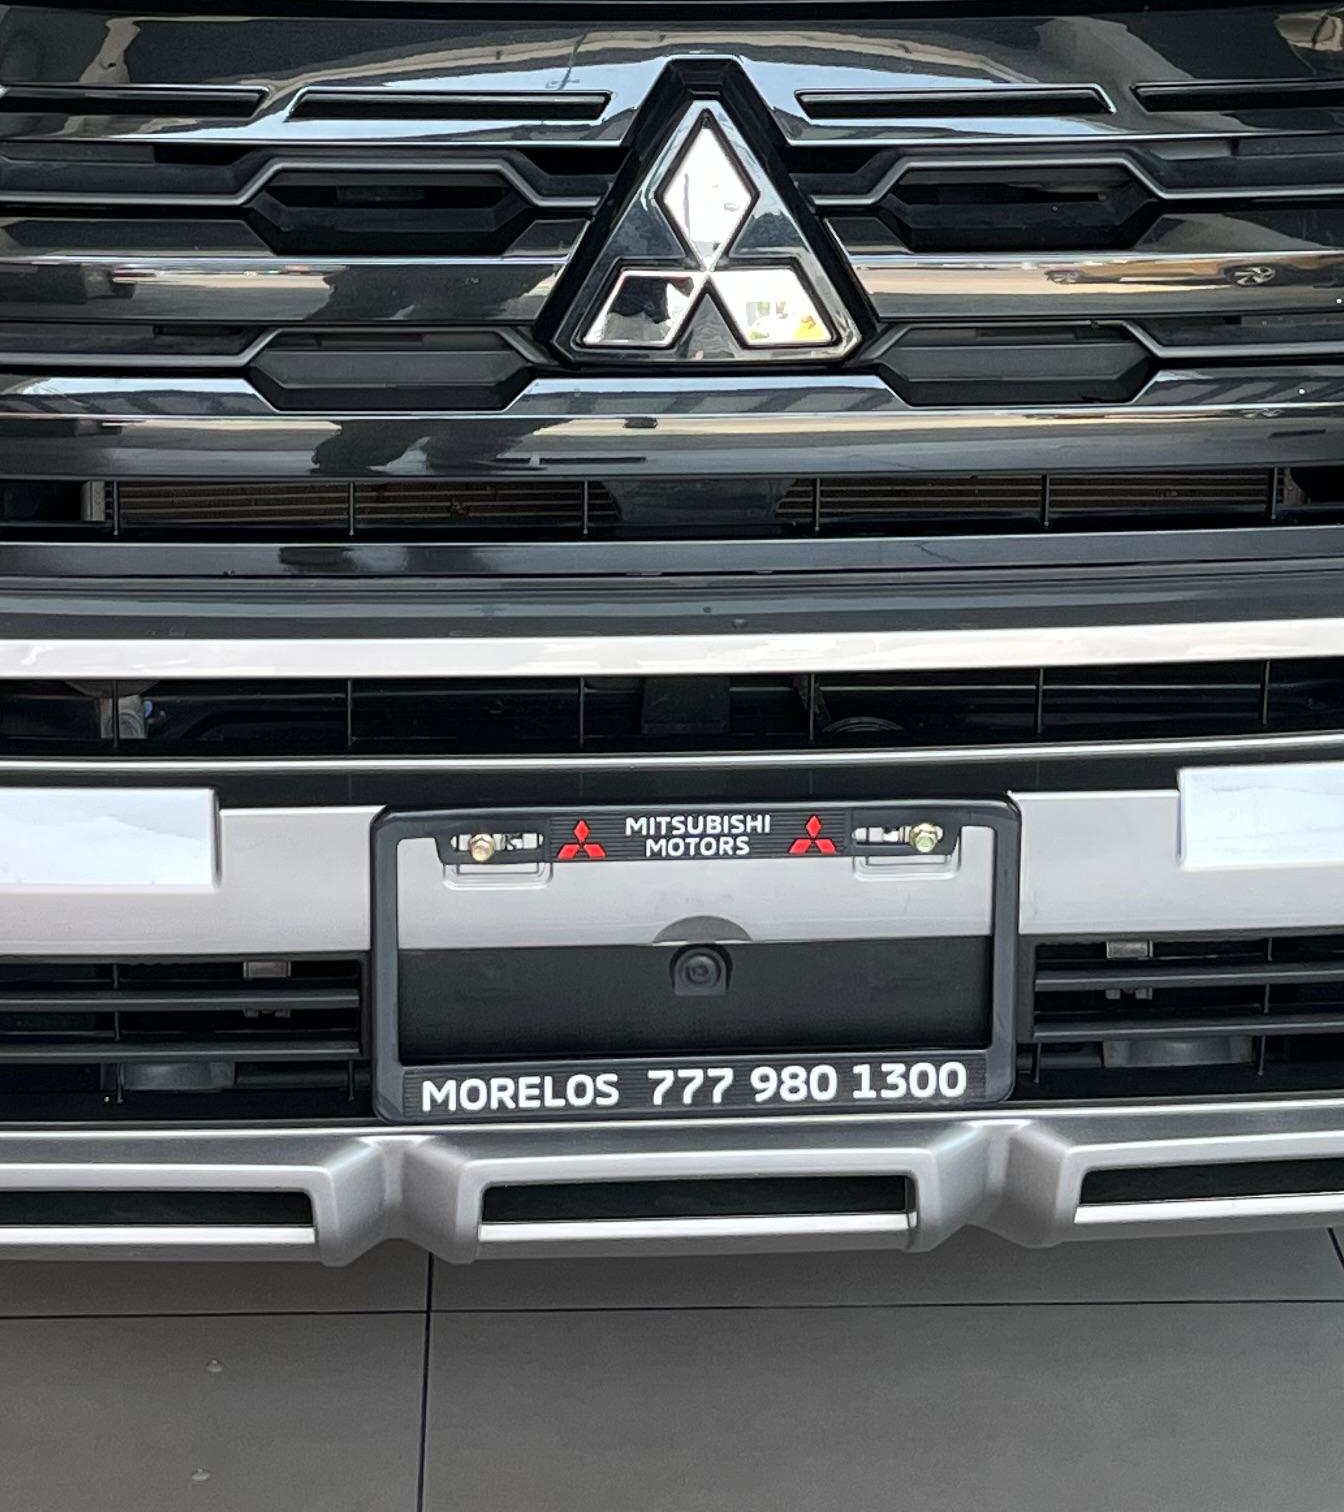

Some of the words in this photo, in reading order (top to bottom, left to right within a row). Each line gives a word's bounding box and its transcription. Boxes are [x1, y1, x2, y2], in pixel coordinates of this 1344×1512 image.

[625, 815, 771, 838] MITSUBISHI
[644, 834, 750, 858] MOTORS
[421, 1072, 620, 1113] MORELOS
[647, 1067, 735, 1106] 777
[749, 1064, 838, 1103] 980
[852, 1060, 967, 1100] 1300
